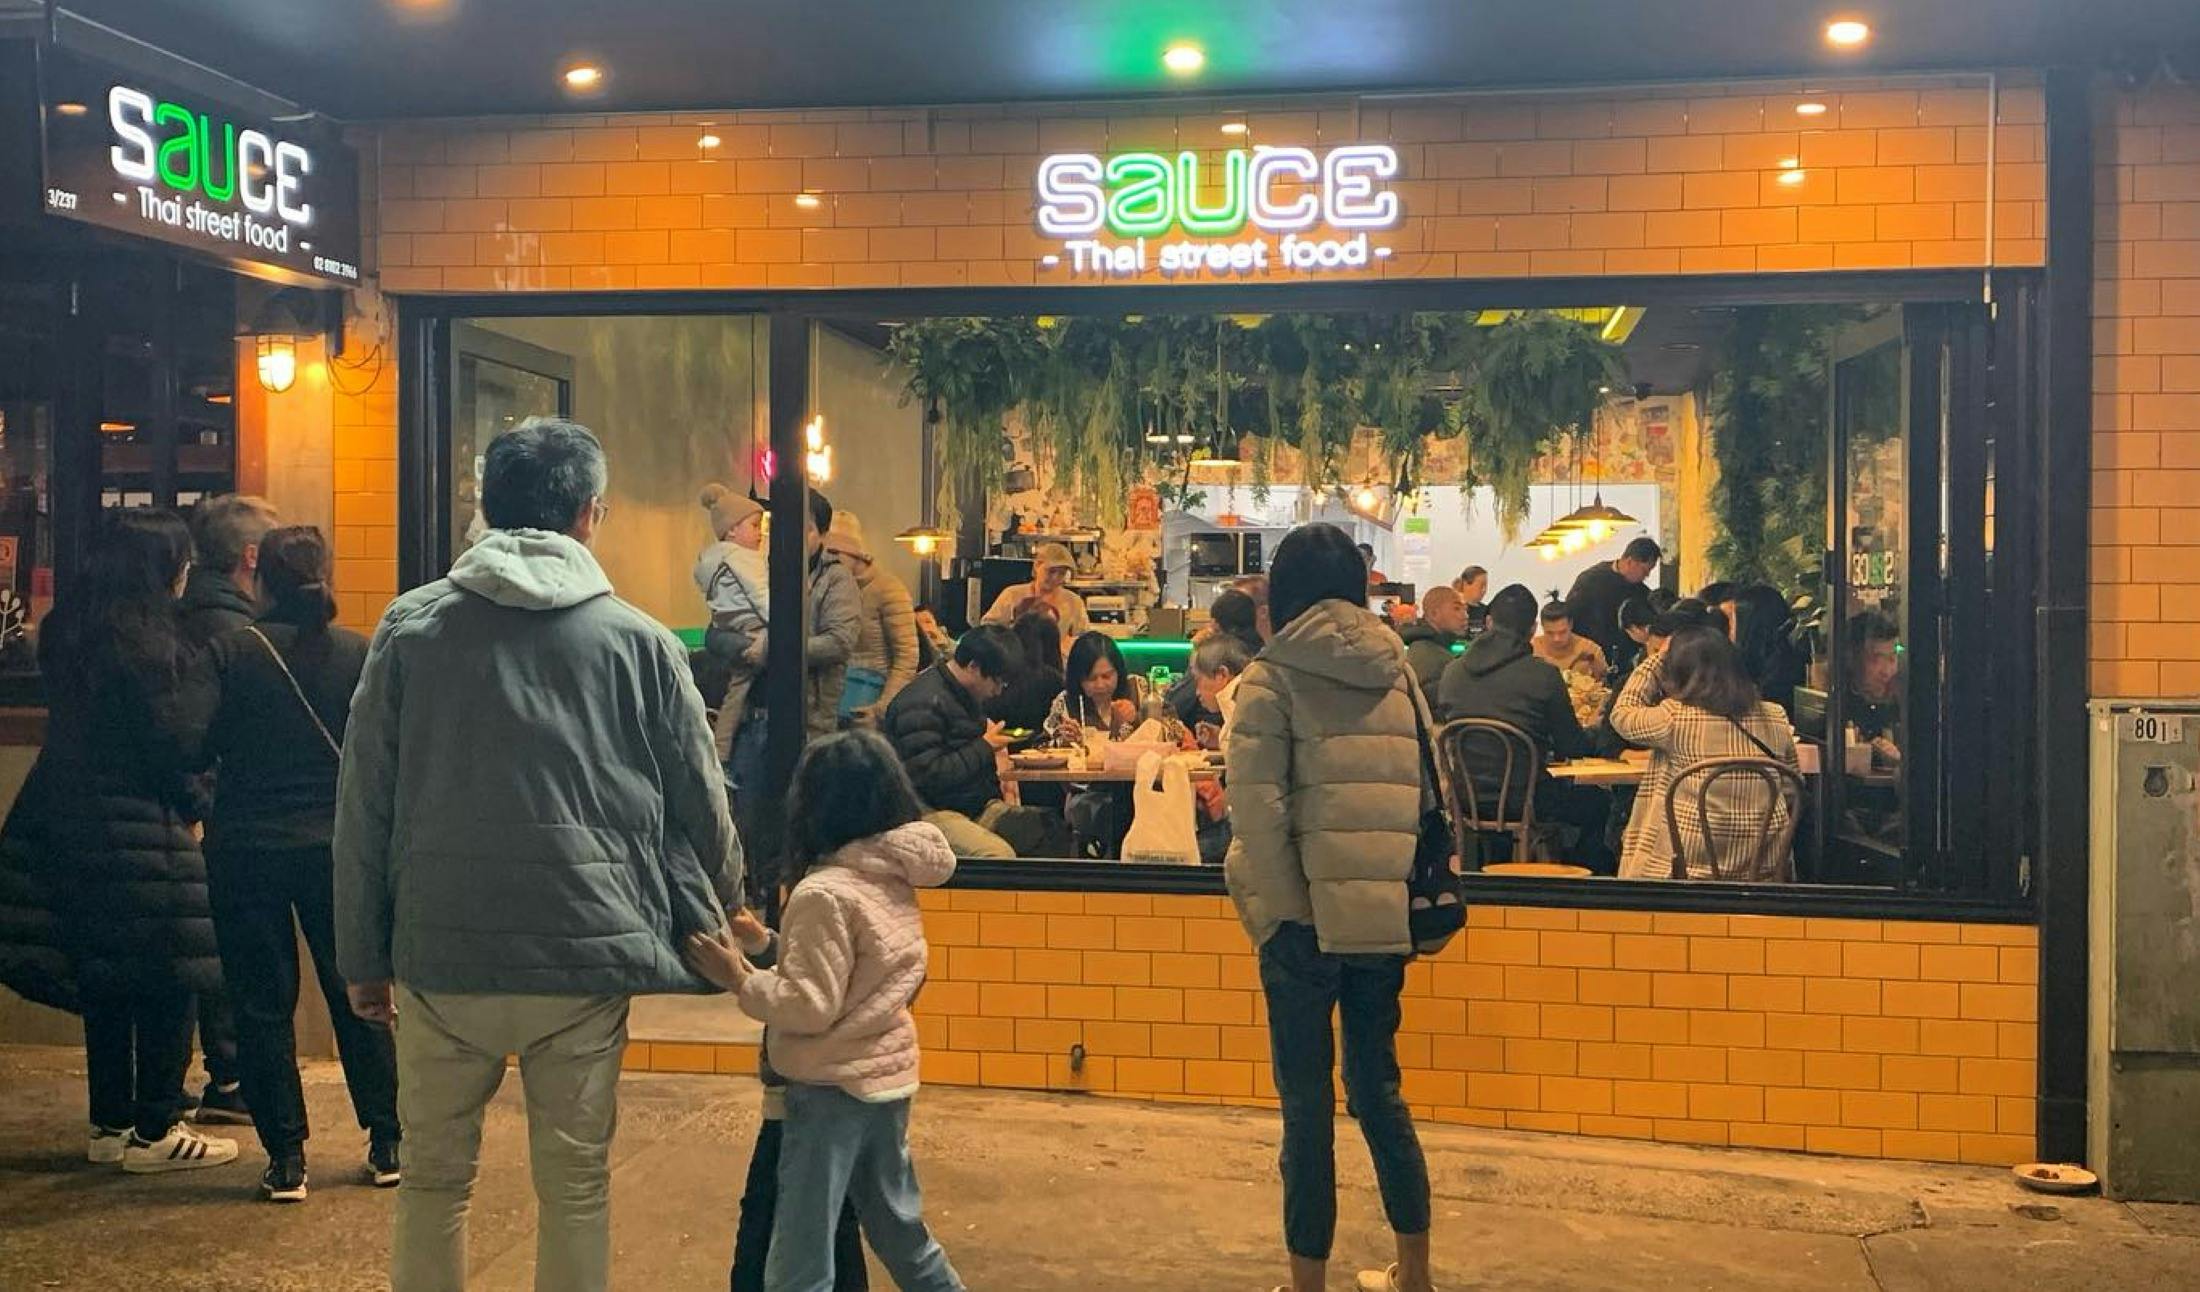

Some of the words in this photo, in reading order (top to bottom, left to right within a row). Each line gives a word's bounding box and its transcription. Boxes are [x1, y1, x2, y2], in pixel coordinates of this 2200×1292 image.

[137, 186, 181, 226] Thai
[185, 201, 240, 241] street
[244, 214, 288, 252] food
[1064, 236, 1145, 272] Thai
[1160, 240, 1268, 270] street
[1280, 233, 1367, 267] food
